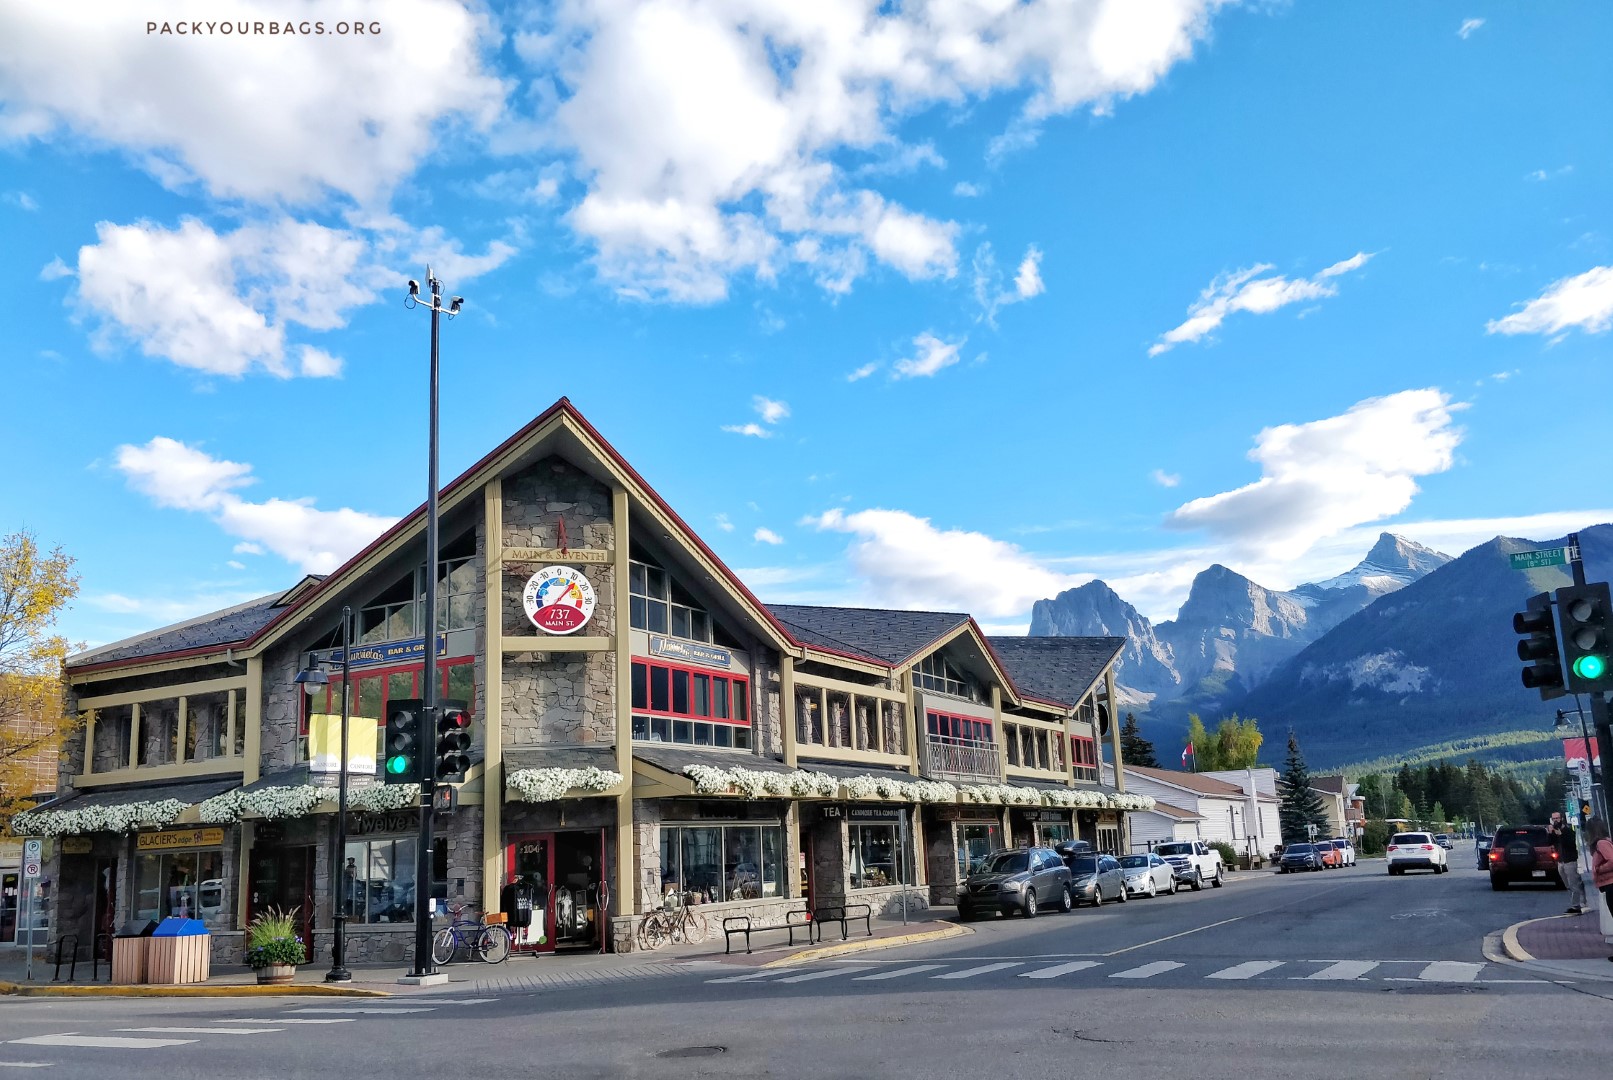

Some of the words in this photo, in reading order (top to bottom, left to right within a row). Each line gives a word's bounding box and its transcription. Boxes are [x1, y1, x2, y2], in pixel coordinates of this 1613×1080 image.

[512, 550, 542, 559] MAIN
[546, 551, 553, 560] &
[556, 551, 605, 561] SEVENTH
[1514, 553, 1532, 561] MAIN
[1535, 549, 1561, 560] STREET
[556, 568, 562, 576] 0
[570, 572, 579, 581] 10
[579, 582, 589, 592] 20
[584, 596, 592, 605] 30
[550, 609, 571, 620] 737
[387, 647, 404, 656] BAR
[823, 807, 841, 817] TEA
[873, 809, 882, 817] TEA
[140, 834, 178, 846] GLACIER'S
[523, 844, 540, 854] 104
